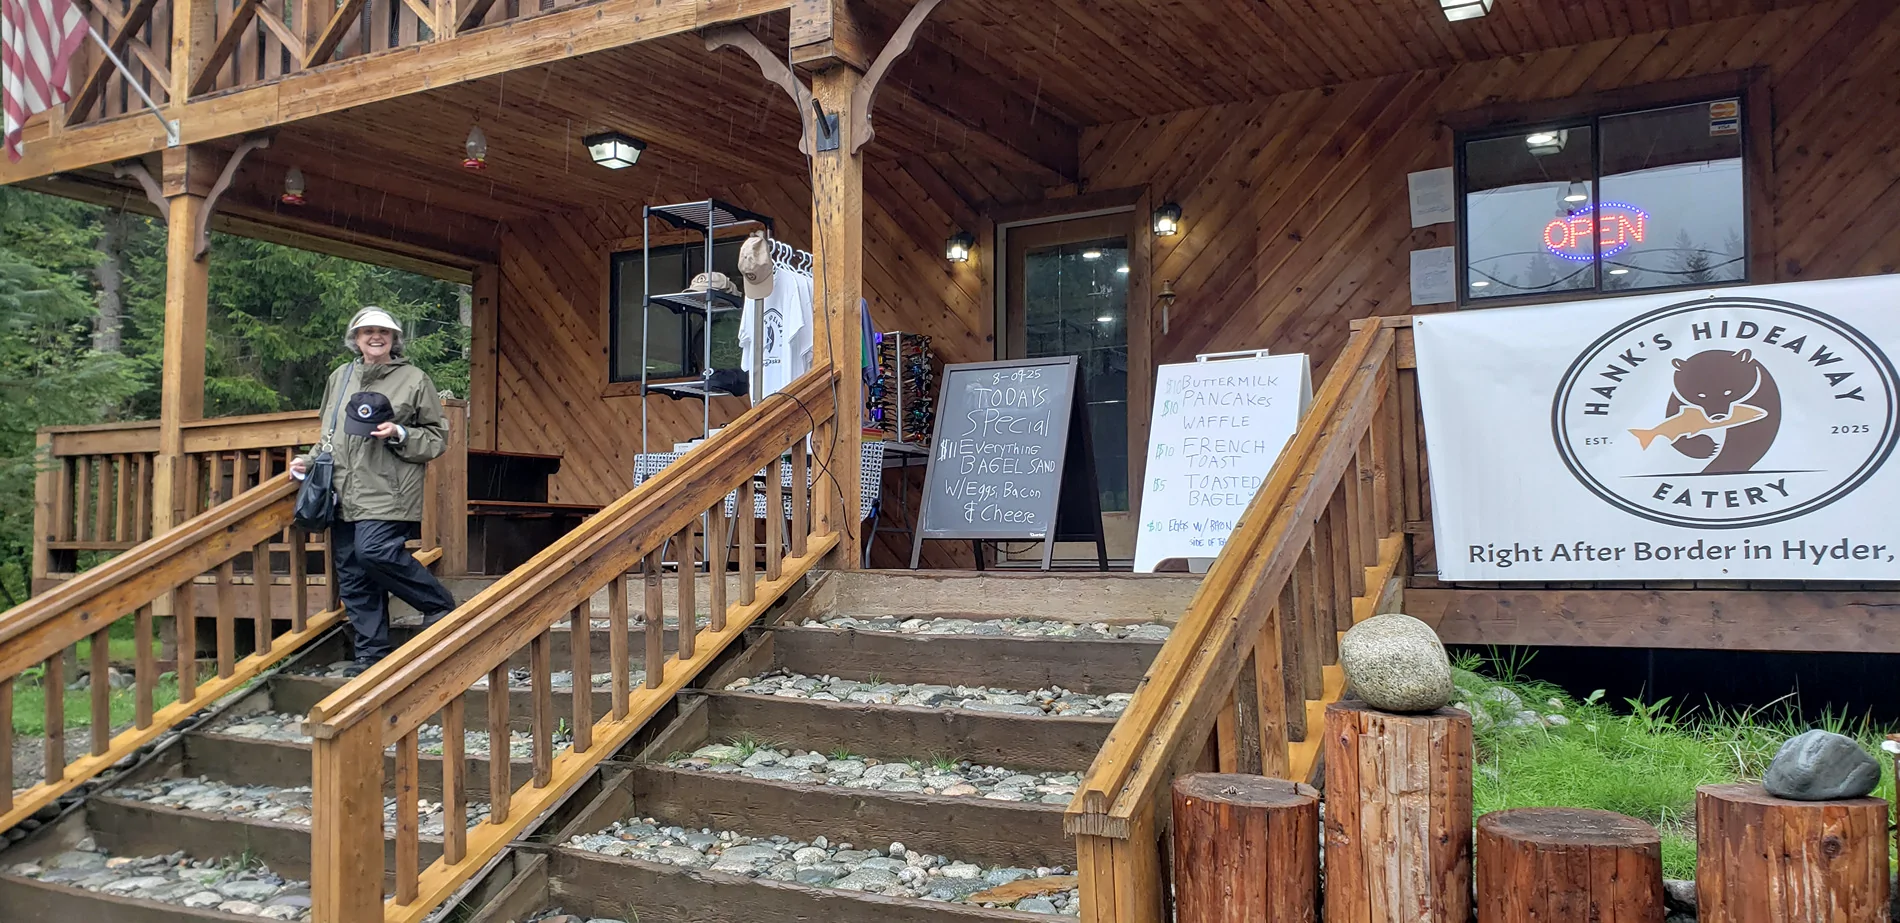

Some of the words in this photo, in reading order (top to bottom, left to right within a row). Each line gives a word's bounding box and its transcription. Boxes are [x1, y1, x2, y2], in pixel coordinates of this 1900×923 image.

[1544, 212, 1645, 249] OPEN
[1584, 332, 1673, 416] HANK'S
[1692, 320, 1865, 404] HIDEAWAY
[1182, 374, 1279, 390] BUTTERMILK
[1183, 415, 1250, 430] WAFFLE
[1831, 424, 1870, 435] 2025
[1155, 443, 1175, 460] $10
[1182, 437, 1265, 455] FRENCH
[1585, 437, 1613, 446] EST.
[960, 455, 1023, 474] BAGEL
[1027, 457, 1056, 475] SAND
[1185, 453, 1242, 469] TOAST
[1003, 481, 1041, 499] Bacon
[1153, 477, 1167, 492] $5
[1184, 474, 1262, 491] TOASTED
[1188, 490, 1245, 507] BAGEL
[1652, 478, 1790, 508] EATERY
[980, 503, 1035, 524] Cheese
[1469, 544, 1543, 568] Right
[1550, 541, 1626, 562] After
[1635, 539, 1736, 561] Border
[1745, 538, 1771, 559] in
[1782, 537, 1896, 566] Hyder,
